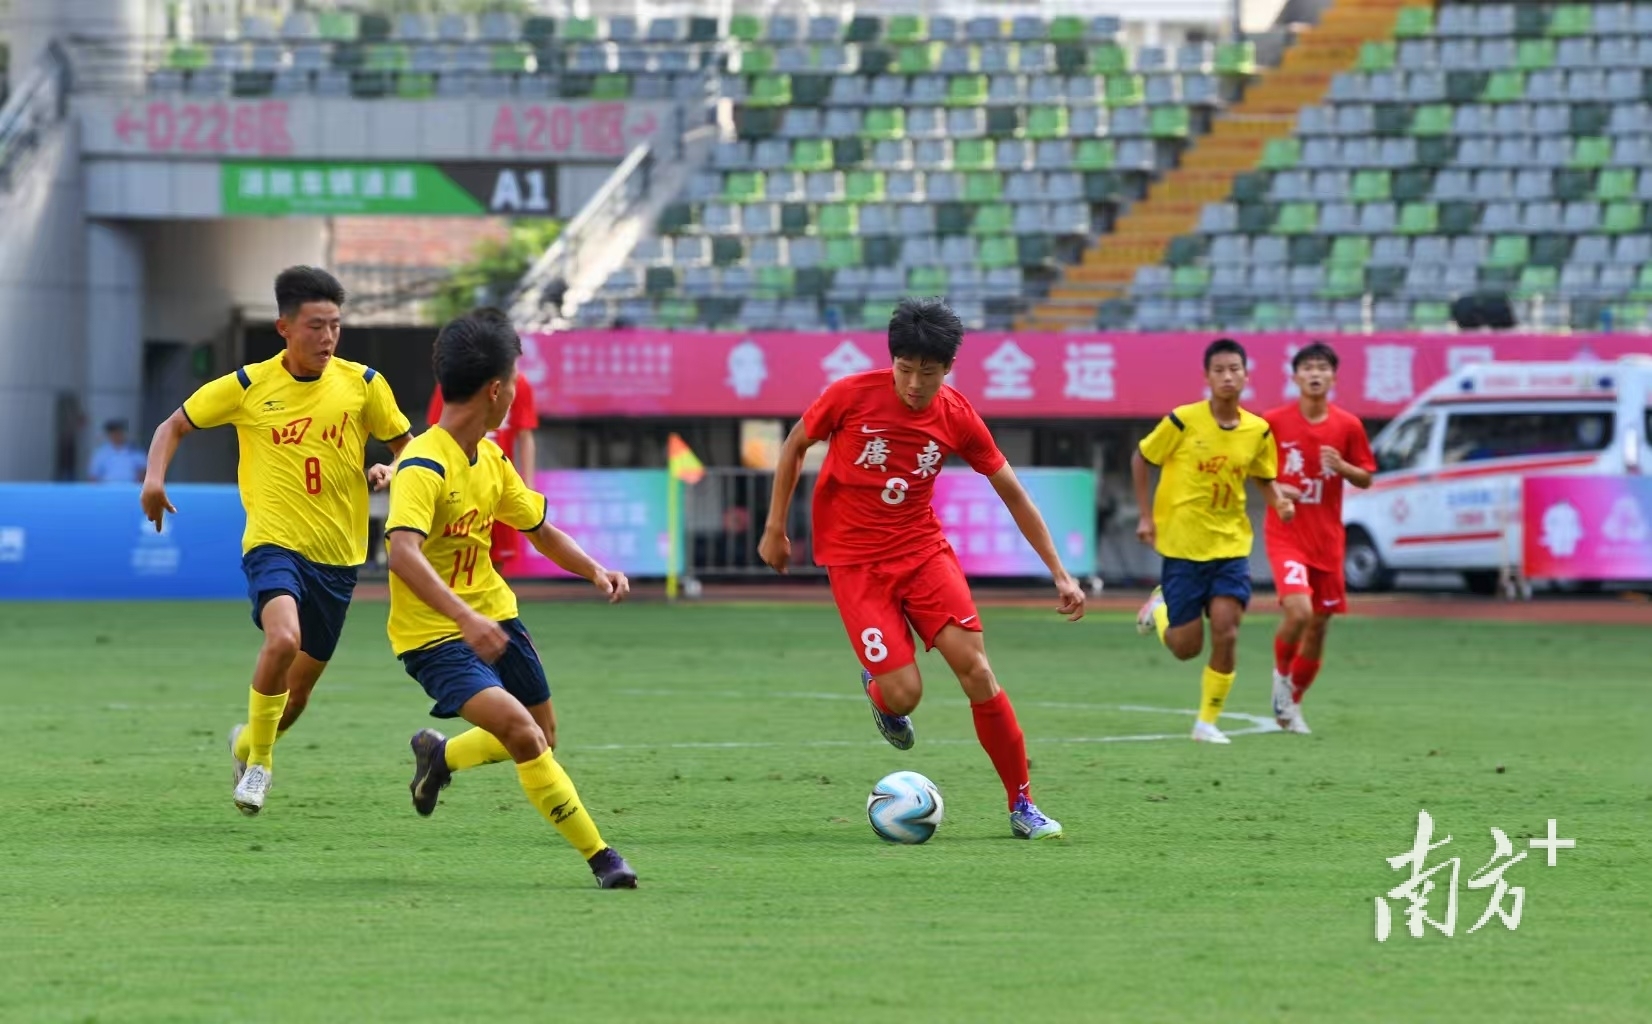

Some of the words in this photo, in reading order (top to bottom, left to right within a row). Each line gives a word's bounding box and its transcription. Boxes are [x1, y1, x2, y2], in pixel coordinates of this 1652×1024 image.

[490, 169, 550, 209] A1
[271, 411, 349, 449] 四川
[305, 456, 322, 495] 8
[853, 435, 942, 480] 廣東
[880, 476, 909, 505] 8
[1211, 481, 1232, 509] 11
[1299, 478, 1322, 503] 21
[449, 544, 479, 588] 14
[860, 627, 889, 663] 8
